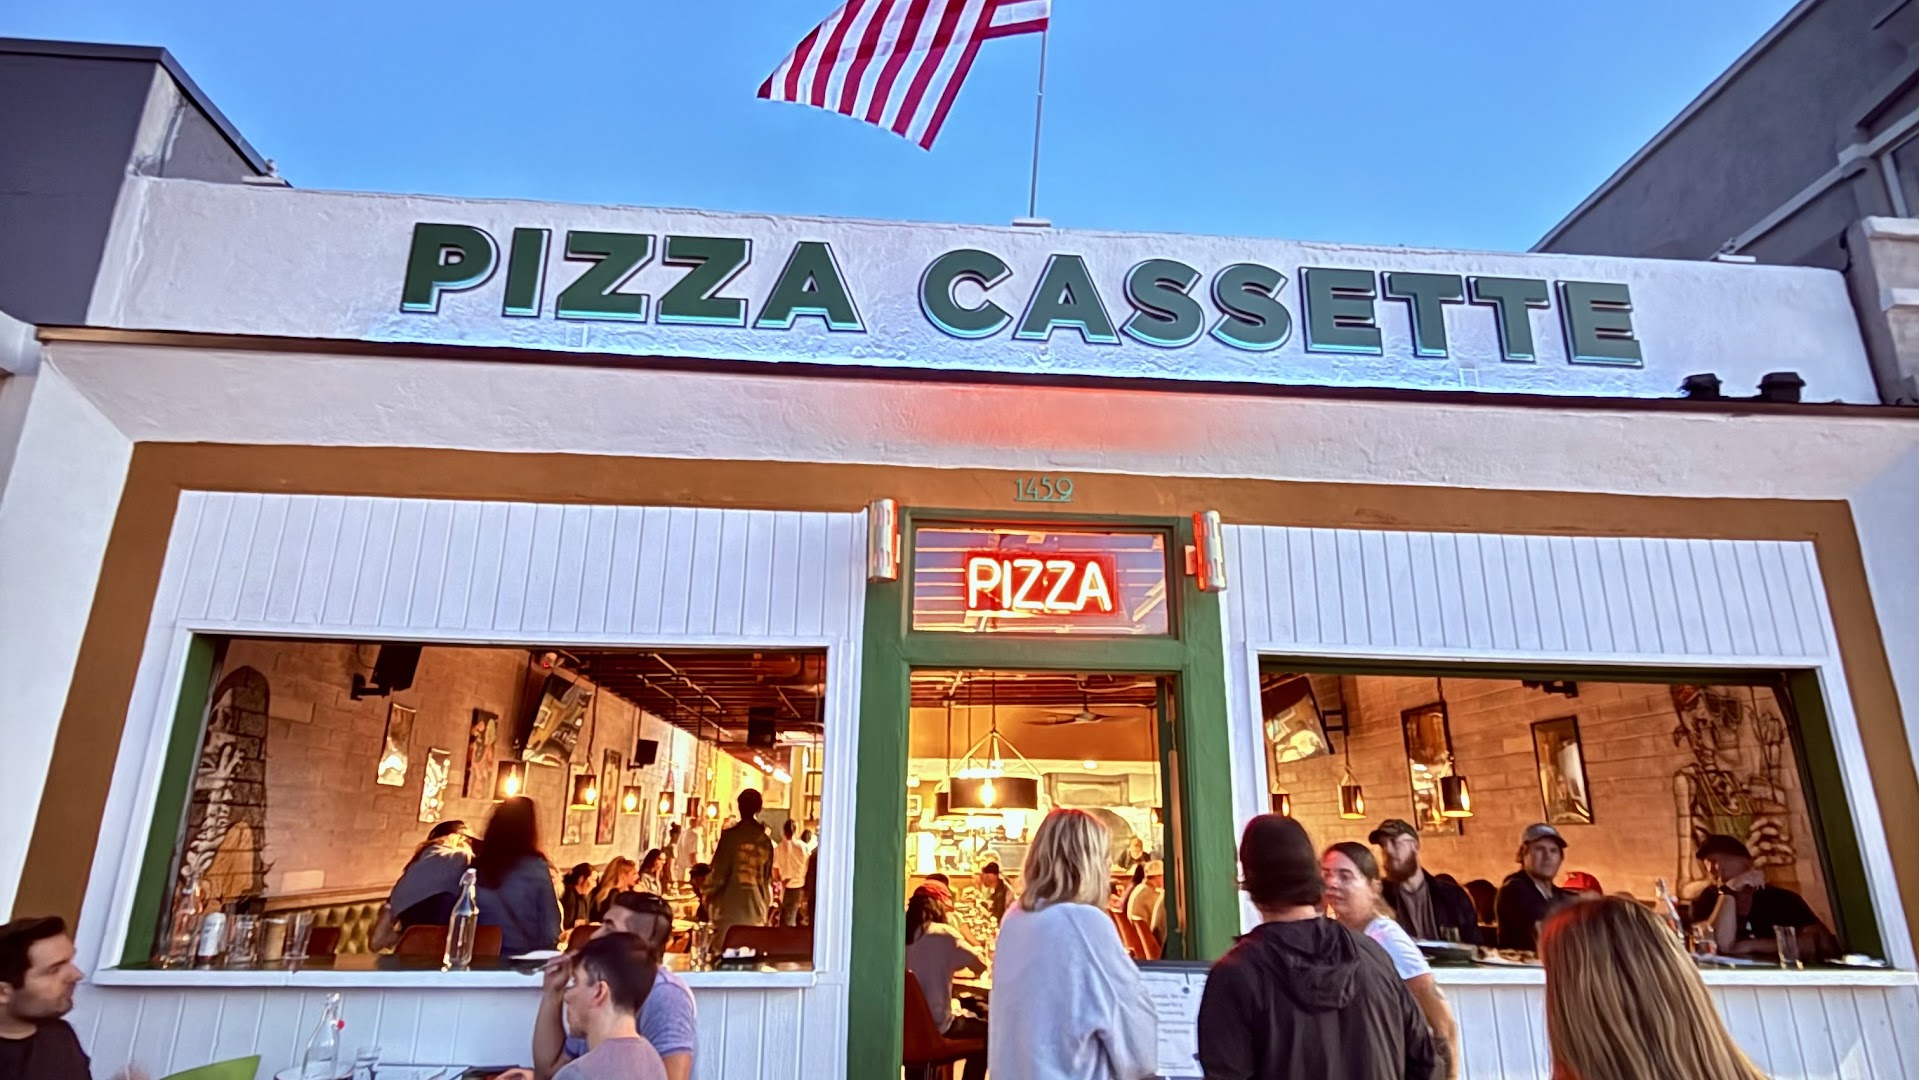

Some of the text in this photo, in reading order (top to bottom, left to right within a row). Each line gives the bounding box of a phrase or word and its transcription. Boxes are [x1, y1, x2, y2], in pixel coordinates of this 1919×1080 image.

[400, 223, 1645, 368] PIZZA CASSETTE
[1015, 477, 1074, 501] 1459
[968, 557, 1113, 612] PIZZA
